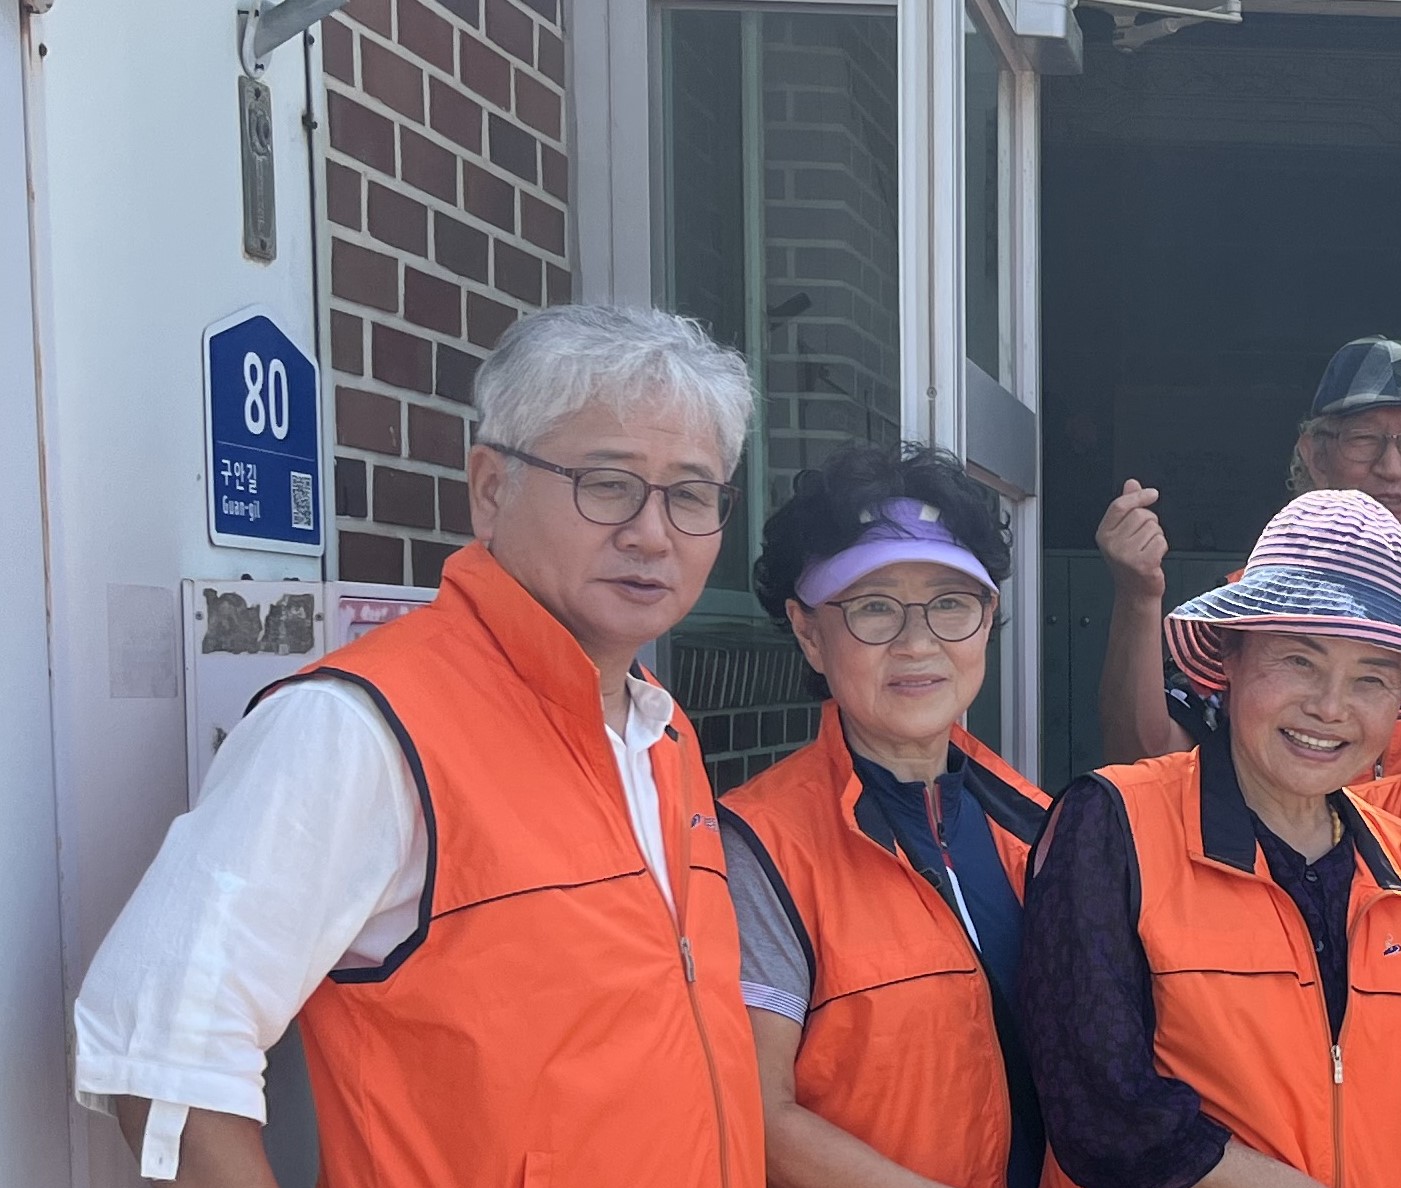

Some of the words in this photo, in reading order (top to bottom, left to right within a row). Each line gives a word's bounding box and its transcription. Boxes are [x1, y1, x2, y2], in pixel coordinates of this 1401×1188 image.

[243, 351, 289, 440] 80
[220, 459, 257, 494] 구안길
[222, 494, 261, 522] Guan-gil
